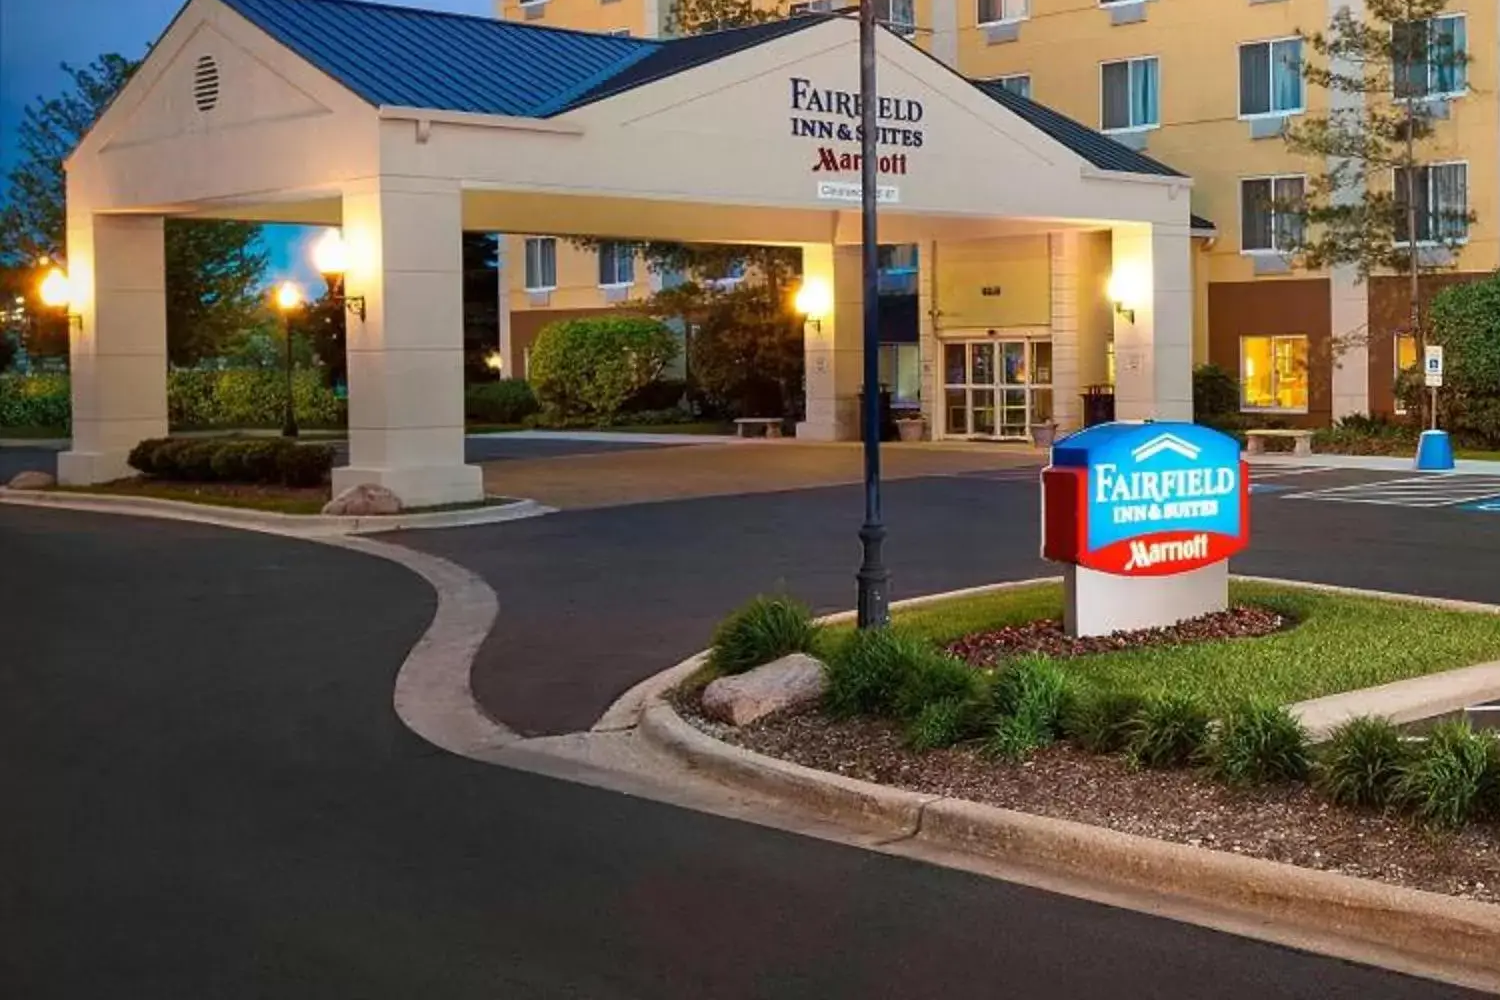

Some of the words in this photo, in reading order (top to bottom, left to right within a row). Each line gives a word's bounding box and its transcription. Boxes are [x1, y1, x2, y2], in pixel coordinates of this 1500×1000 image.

[790, 77, 923, 123] FAIRFELD
[790, 117, 835, 139] INN
[837, 123, 853, 142] &
[855, 124, 923, 147] SITES
[812, 147, 907, 175] Marott
[1095, 463, 1236, 503] FAIRFIELD
[1113, 505, 1147, 524] INN
[1124, 533, 1208, 571] Marriott
